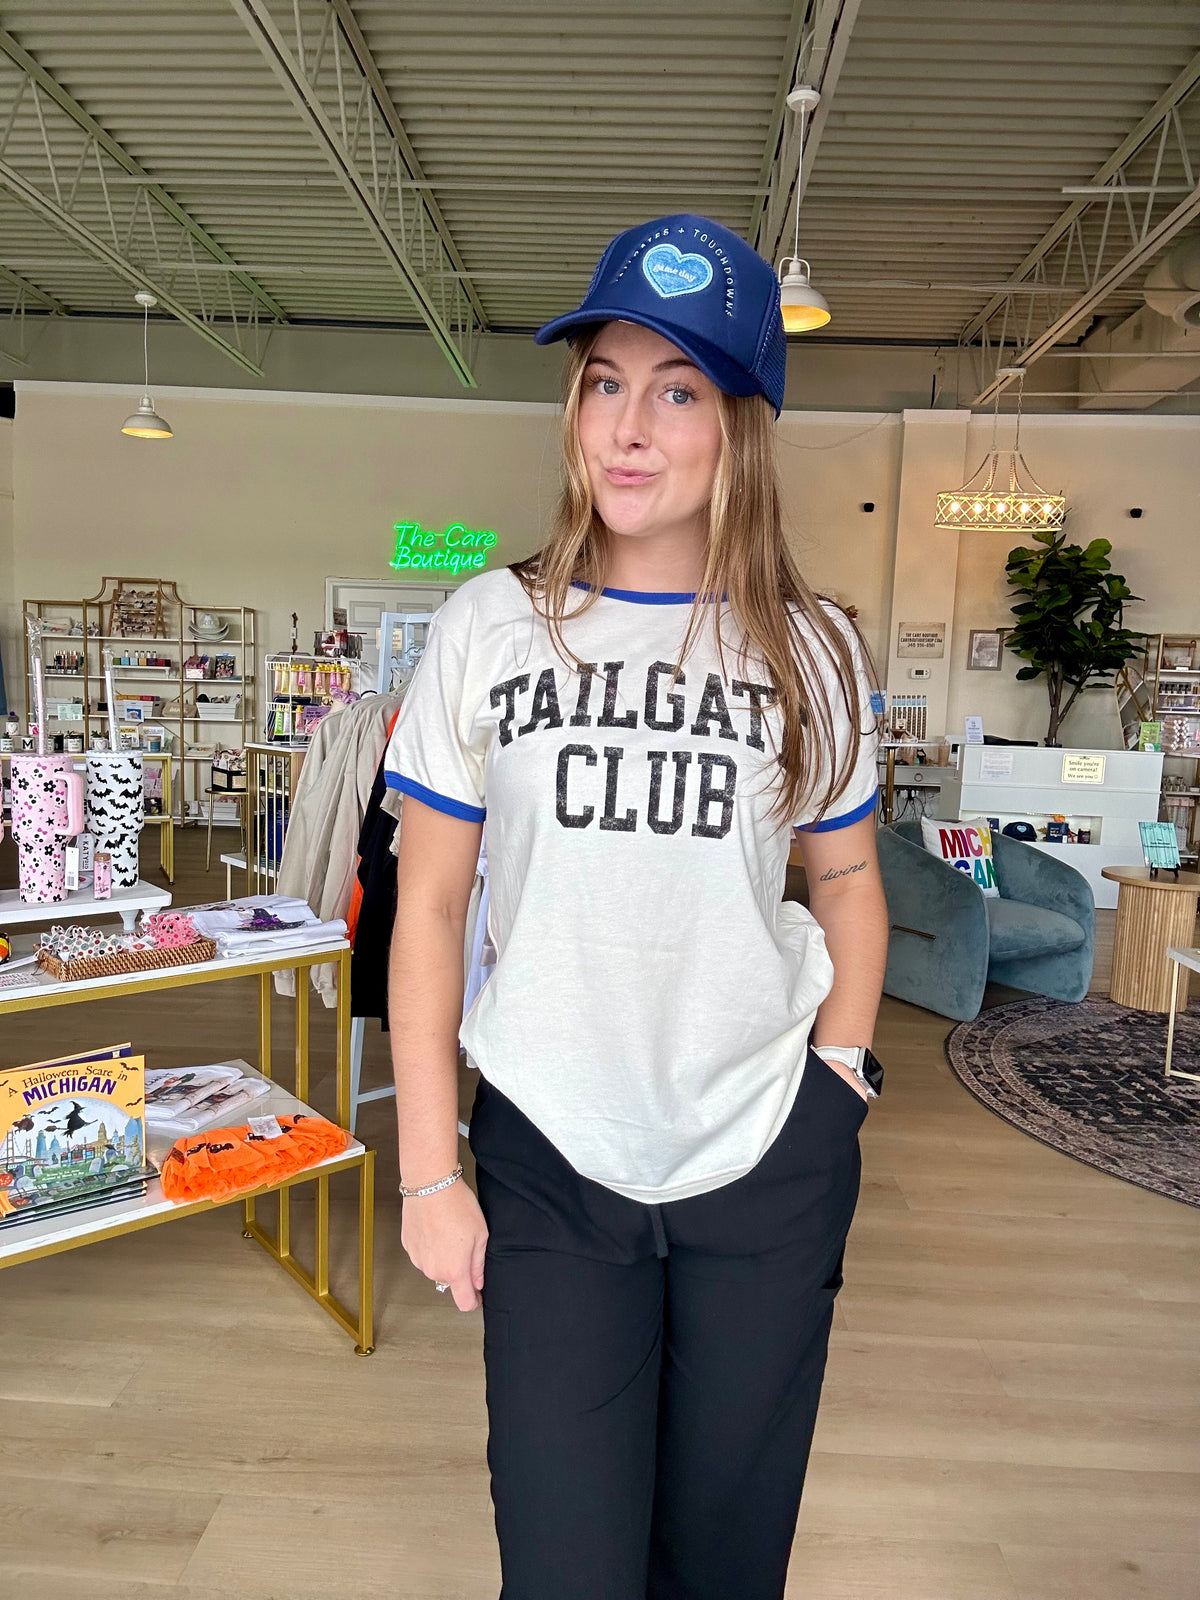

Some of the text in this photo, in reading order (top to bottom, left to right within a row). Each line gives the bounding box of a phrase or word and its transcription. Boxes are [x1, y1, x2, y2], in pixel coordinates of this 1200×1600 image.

[694, 228, 735, 318] TOUCHDOWNS
[395, 524, 497, 547] The Care
[390, 546, 485, 574] Boutique
[489, 659, 808, 769] TAILGAT
[22, 739, 34, 750] M
[555, 743, 738, 840] CLUB
[938, 826, 993, 859] MICH
[819, 860, 867, 881] divine
[8, 1065, 128, 1098] A Halloween Scare in
[22, 1075, 117, 1107] MICHIGAN
